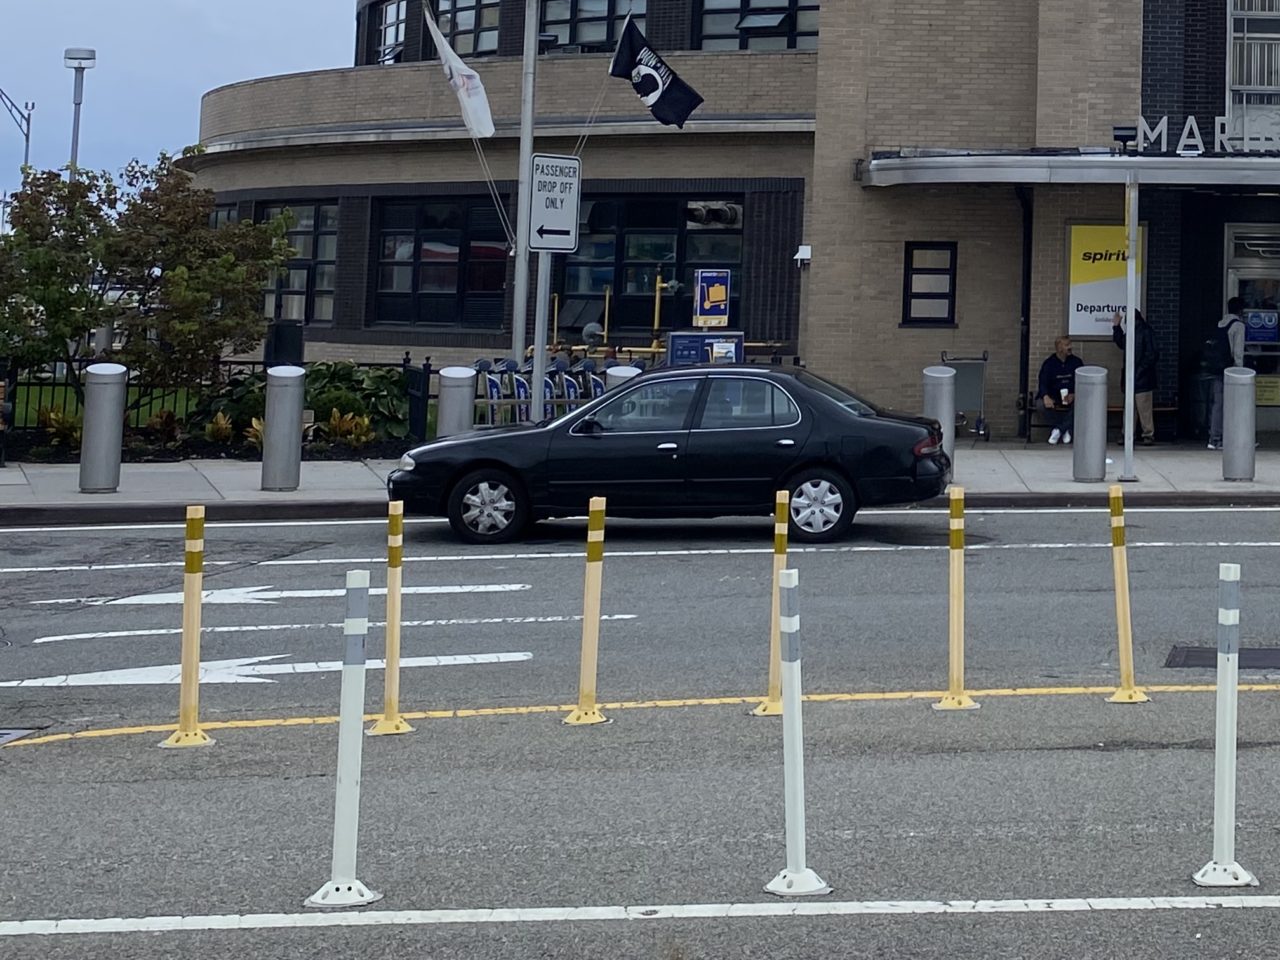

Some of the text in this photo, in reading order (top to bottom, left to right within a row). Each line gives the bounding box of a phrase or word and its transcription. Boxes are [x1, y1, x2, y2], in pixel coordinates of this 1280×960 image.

[535, 163, 577, 178] PASSENGER
[537, 180, 573, 194] DROP OFF
[545, 196, 565, 209] ONLY
[1081, 250, 1129, 263] spirit
[1076, 303, 1127, 314] Departure
